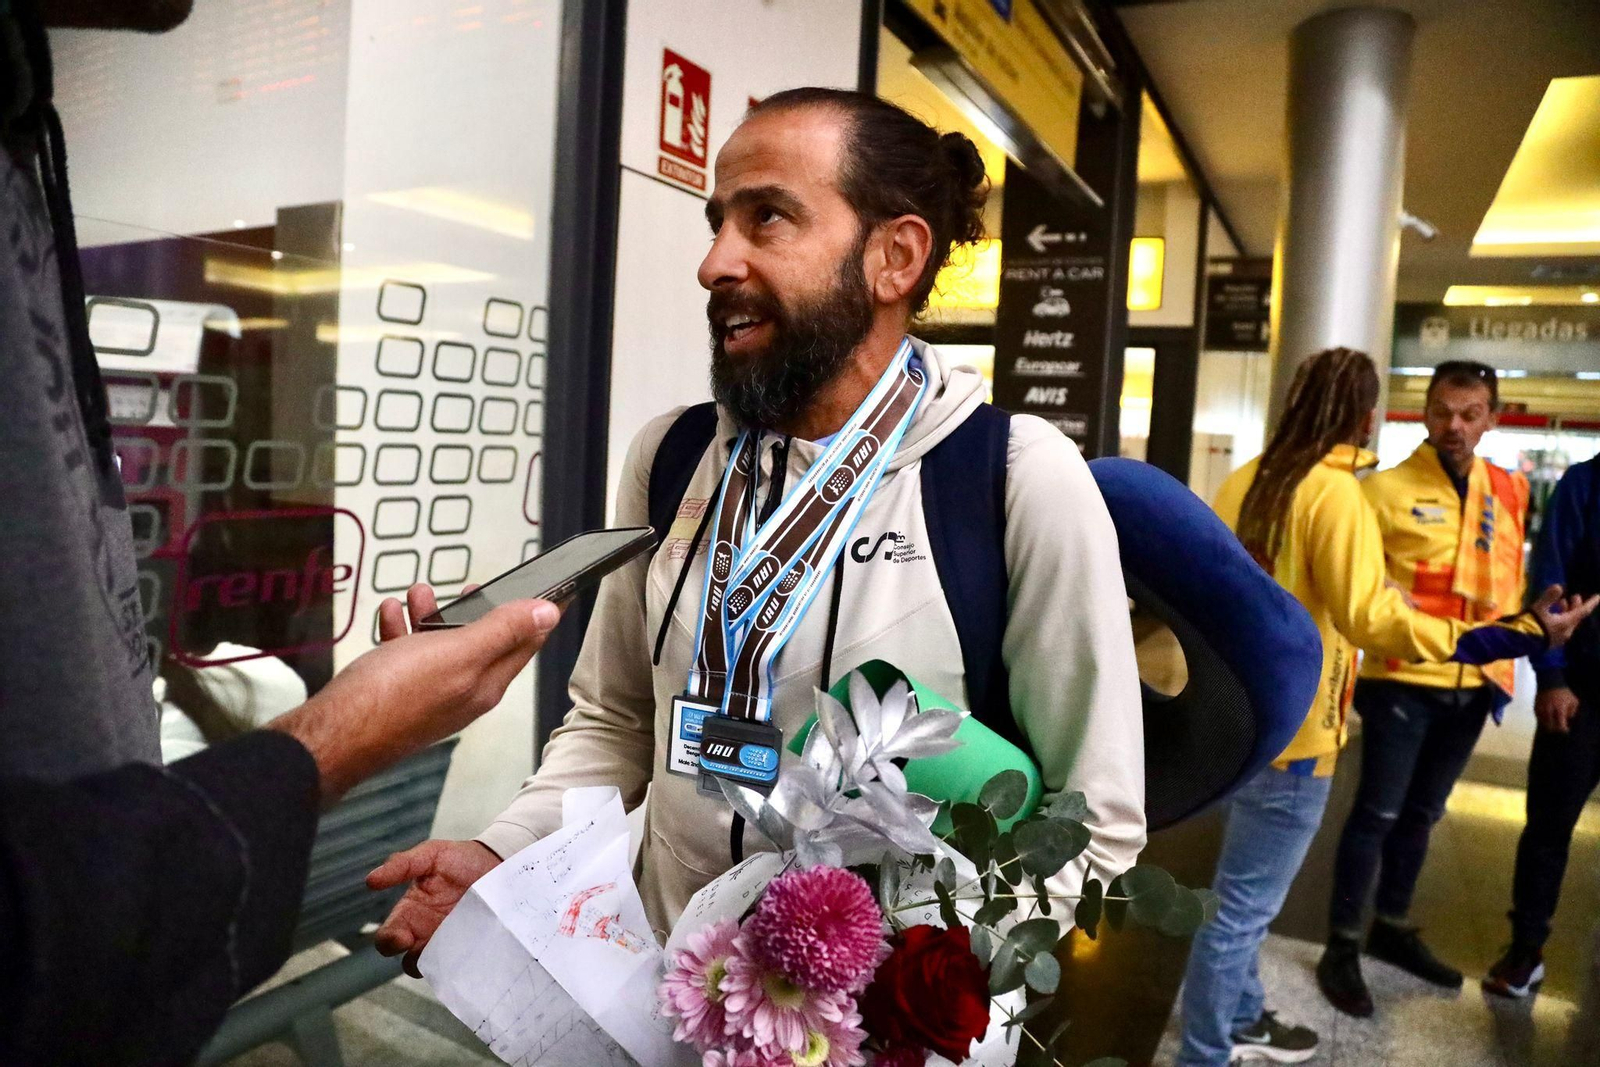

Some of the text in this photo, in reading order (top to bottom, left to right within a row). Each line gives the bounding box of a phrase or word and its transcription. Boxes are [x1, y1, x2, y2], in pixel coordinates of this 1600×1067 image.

[1004, 266, 1104, 280] RENT A CAR
[1023, 330, 1075, 348] Hertz
[1470, 316, 1588, 344] Llegadas
[1015, 357, 1082, 374] Europcar
[1024, 386, 1068, 405] AVIS
[853, 440, 873, 468] IAU
[893, 549, 916, 557] Superior
[901, 555, 926, 563] Deportes
[186, 547, 353, 616] renfe
[753, 561, 773, 588] IAU
[711, 585, 722, 611] IAU
[761, 597, 780, 624] IAU
[707, 743, 734, 758] IAU
